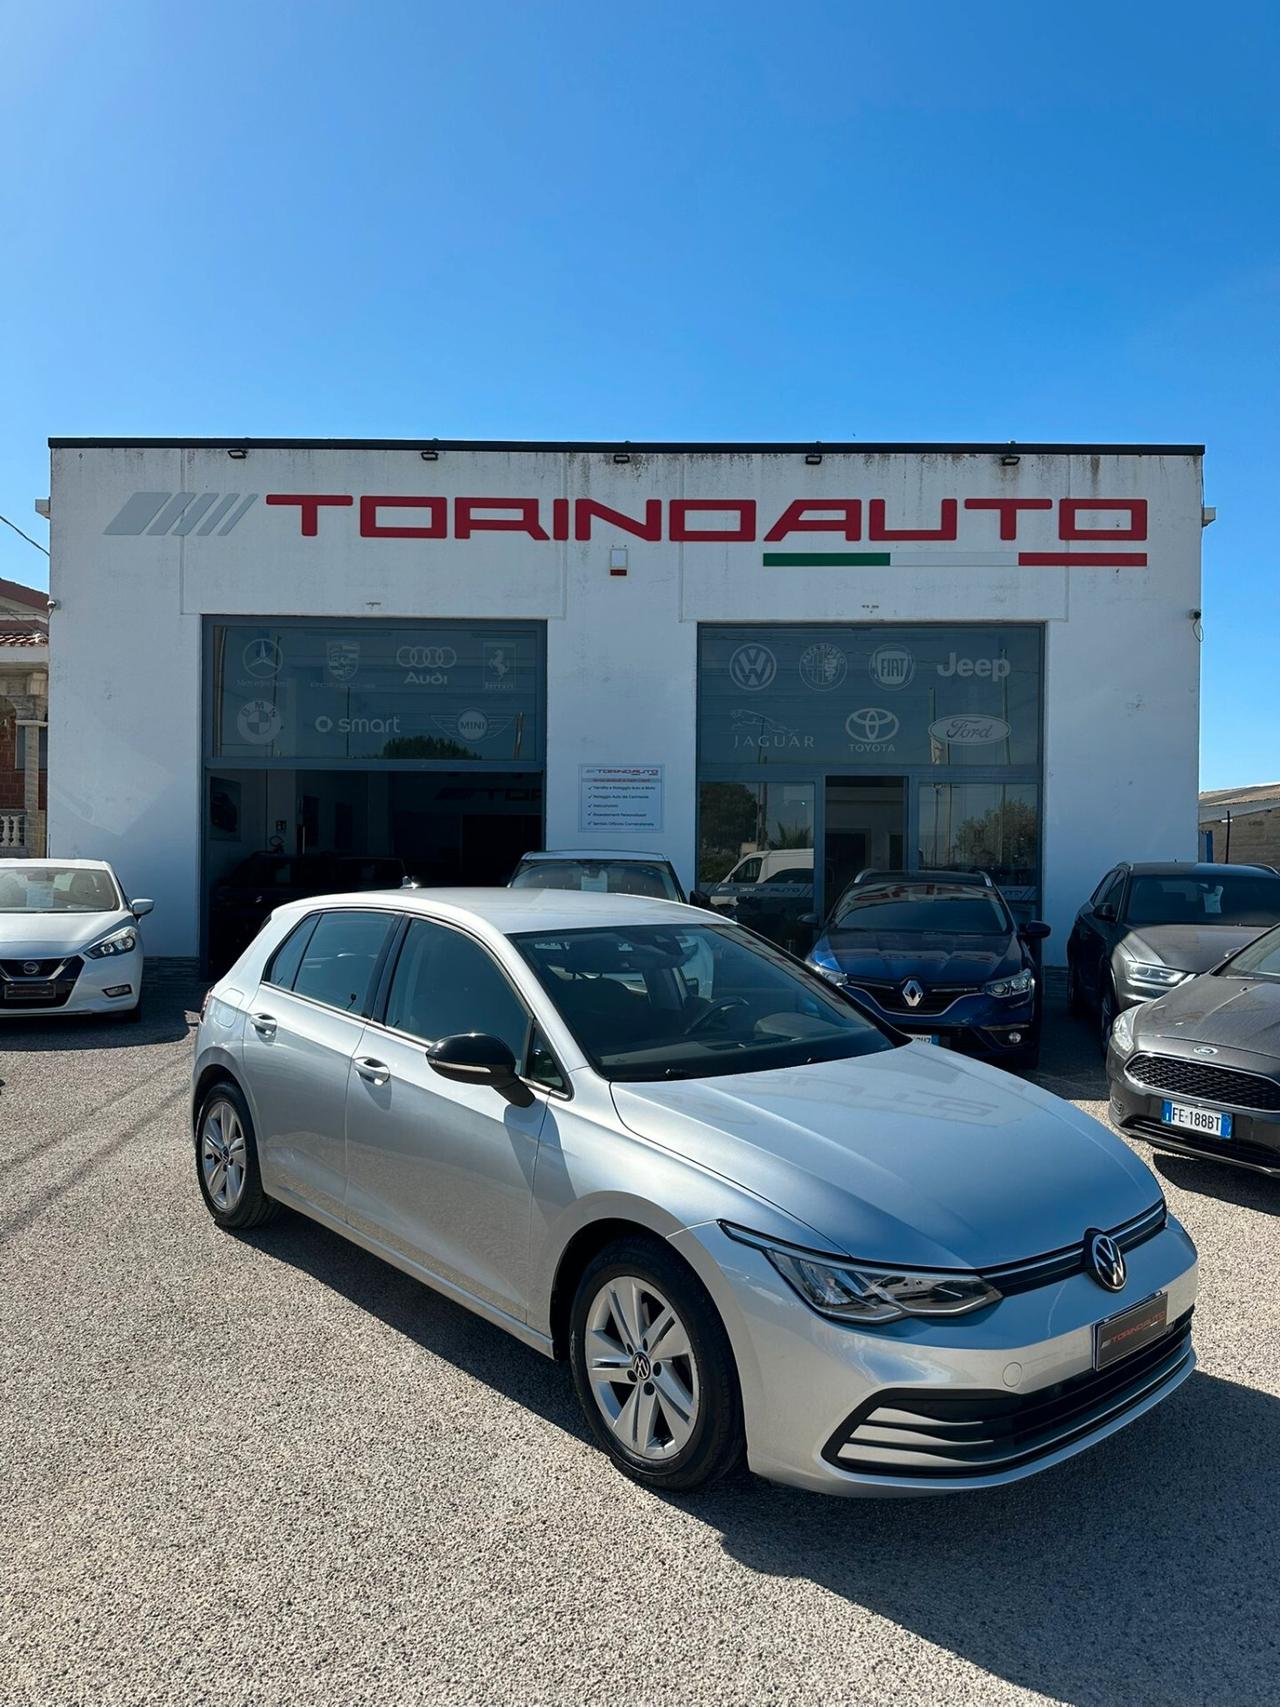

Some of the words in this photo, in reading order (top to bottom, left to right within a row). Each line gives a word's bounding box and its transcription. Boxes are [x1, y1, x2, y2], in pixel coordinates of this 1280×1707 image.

[266, 494, 1148, 542] TORINOAUTO
[880, 657, 906, 677] FIAT
[936, 652, 1011, 682] Jeep
[404, 671, 448, 685] Audi
[338, 716, 400, 733] smart
[460, 719, 486, 730] MINI
[946, 718, 993, 739] Ford
[734, 735, 815, 748] JAGUAR
[848, 743, 896, 753] TOYOTA
